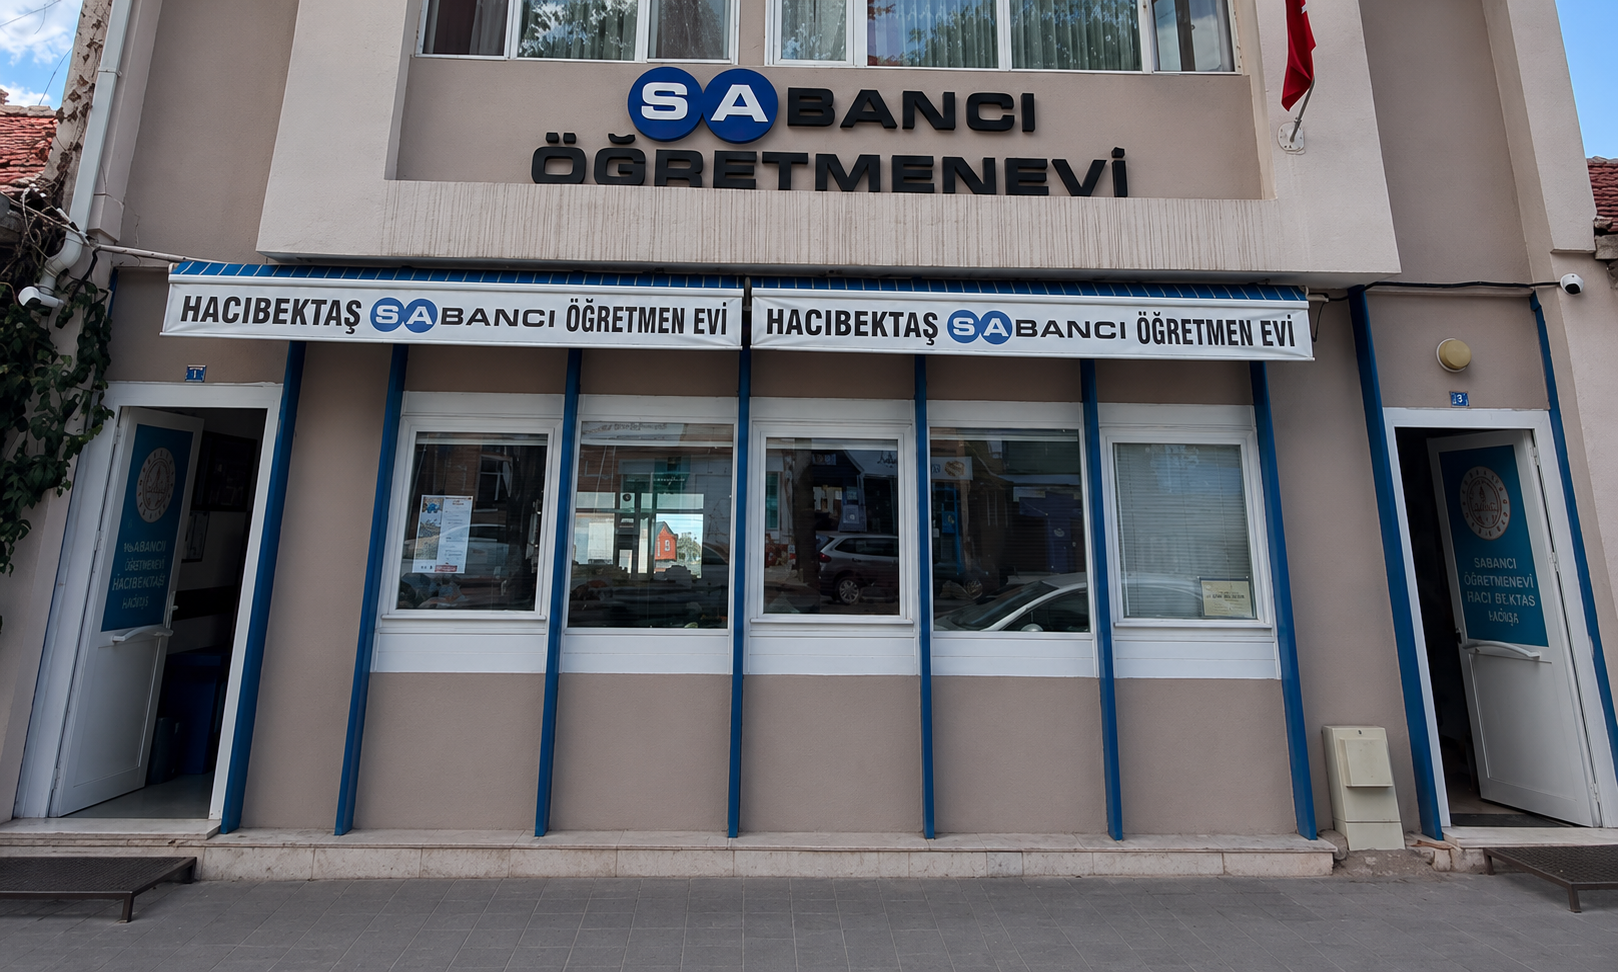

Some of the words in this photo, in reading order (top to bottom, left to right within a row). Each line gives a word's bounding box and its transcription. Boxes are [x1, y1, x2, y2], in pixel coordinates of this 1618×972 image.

[638, 77, 1036, 135] SABANCI
[531, 131, 1129, 198] ÖĞRETMENEVİ
[180, 295, 362, 334] HACIBEKTAŞ
[373, 299, 556, 332] SABANCI
[566, 297, 685, 335] ÖĞRETMEN
[693, 301, 728, 336] EVİ
[766, 308, 939, 344] HACIBEKTAŞ
[950, 312, 1126, 342] SABANCI
[1136, 310, 1253, 347] ÖĞRETMEN
[1261, 314, 1296, 348] EVİ
[1463, 571, 1535, 588] ÖĞRETMENEVİ
[1474, 557, 1517, 569] SABANCI
[1466, 590, 1492, 604] HACI
